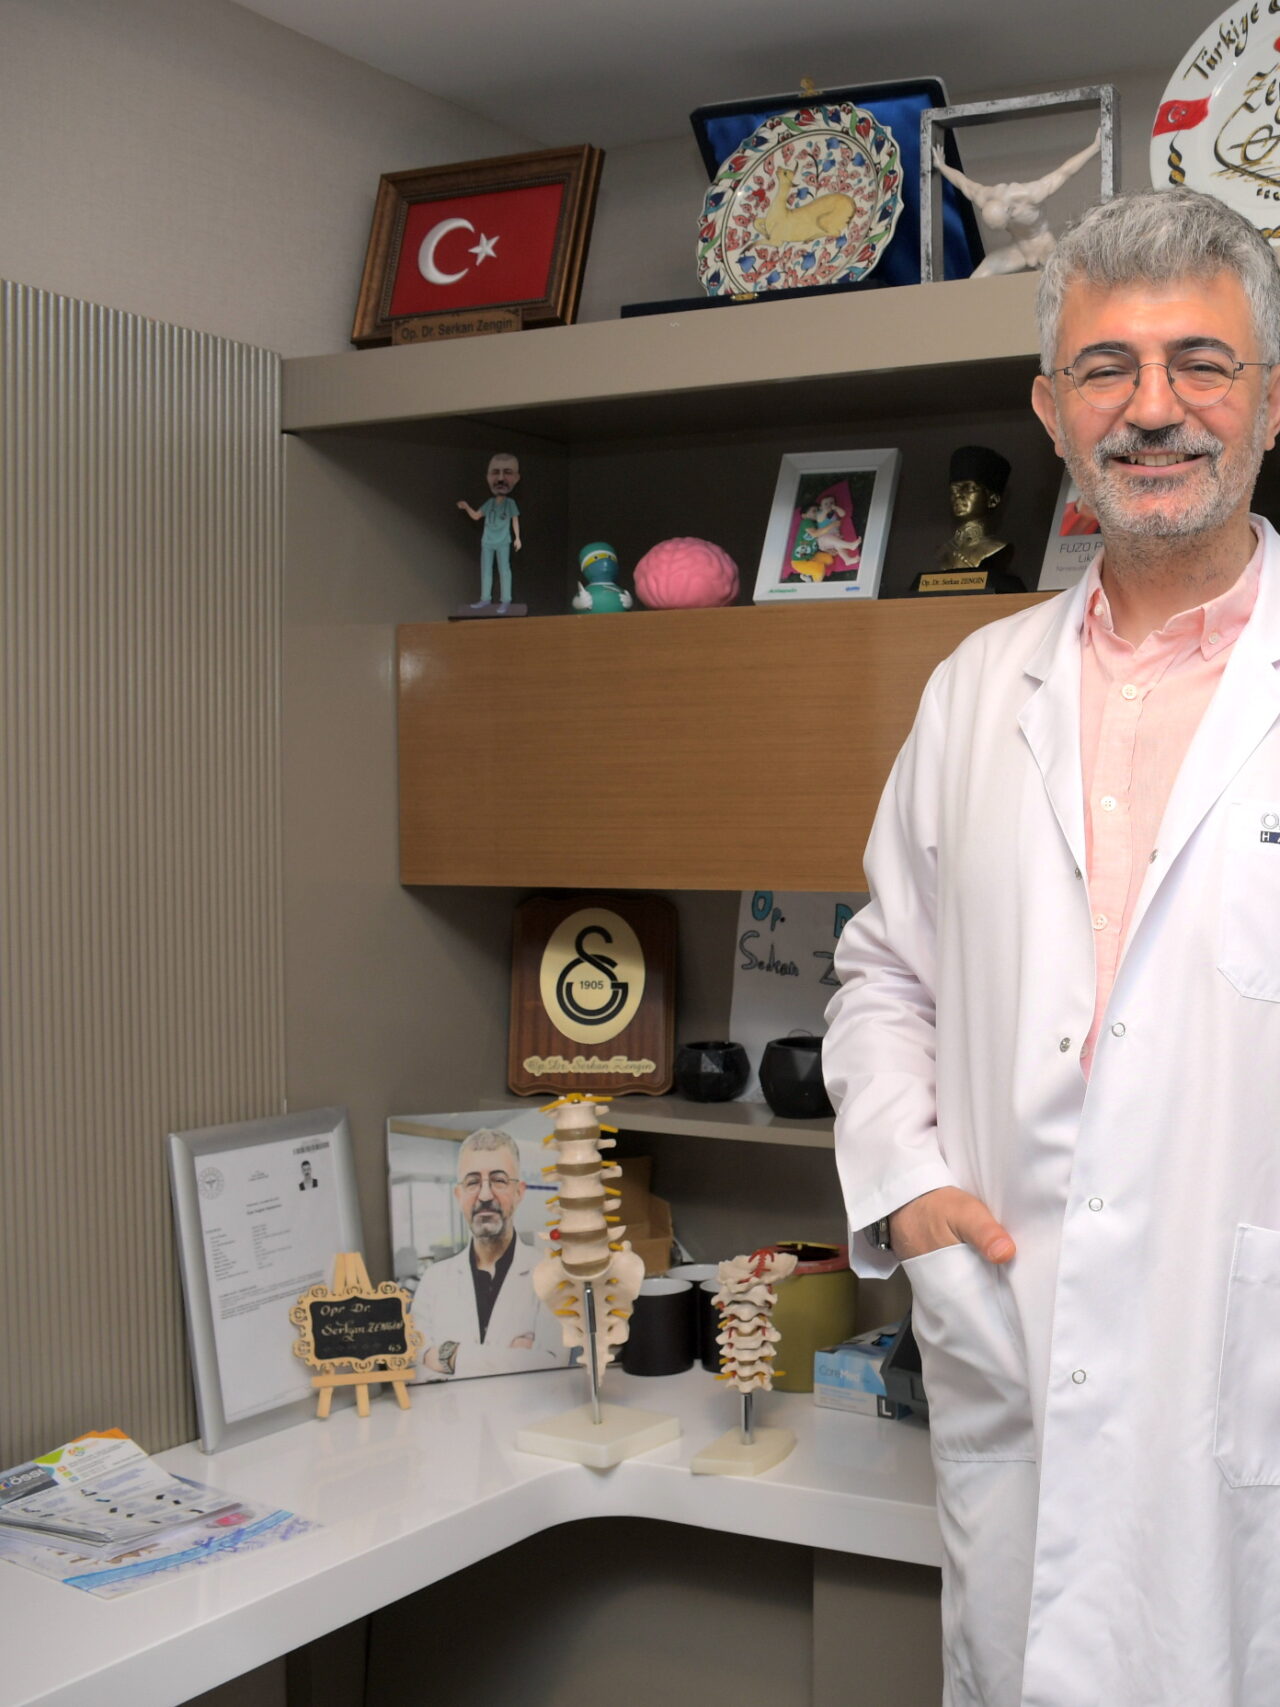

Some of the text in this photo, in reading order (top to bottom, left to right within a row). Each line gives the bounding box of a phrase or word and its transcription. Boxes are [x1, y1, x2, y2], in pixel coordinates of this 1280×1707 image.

[438, 322, 474, 336] Serkan
[476, 318, 513, 333] Zengin
[580, 981, 604, 990] 1905
[882, 1399, 892, 1416] L
